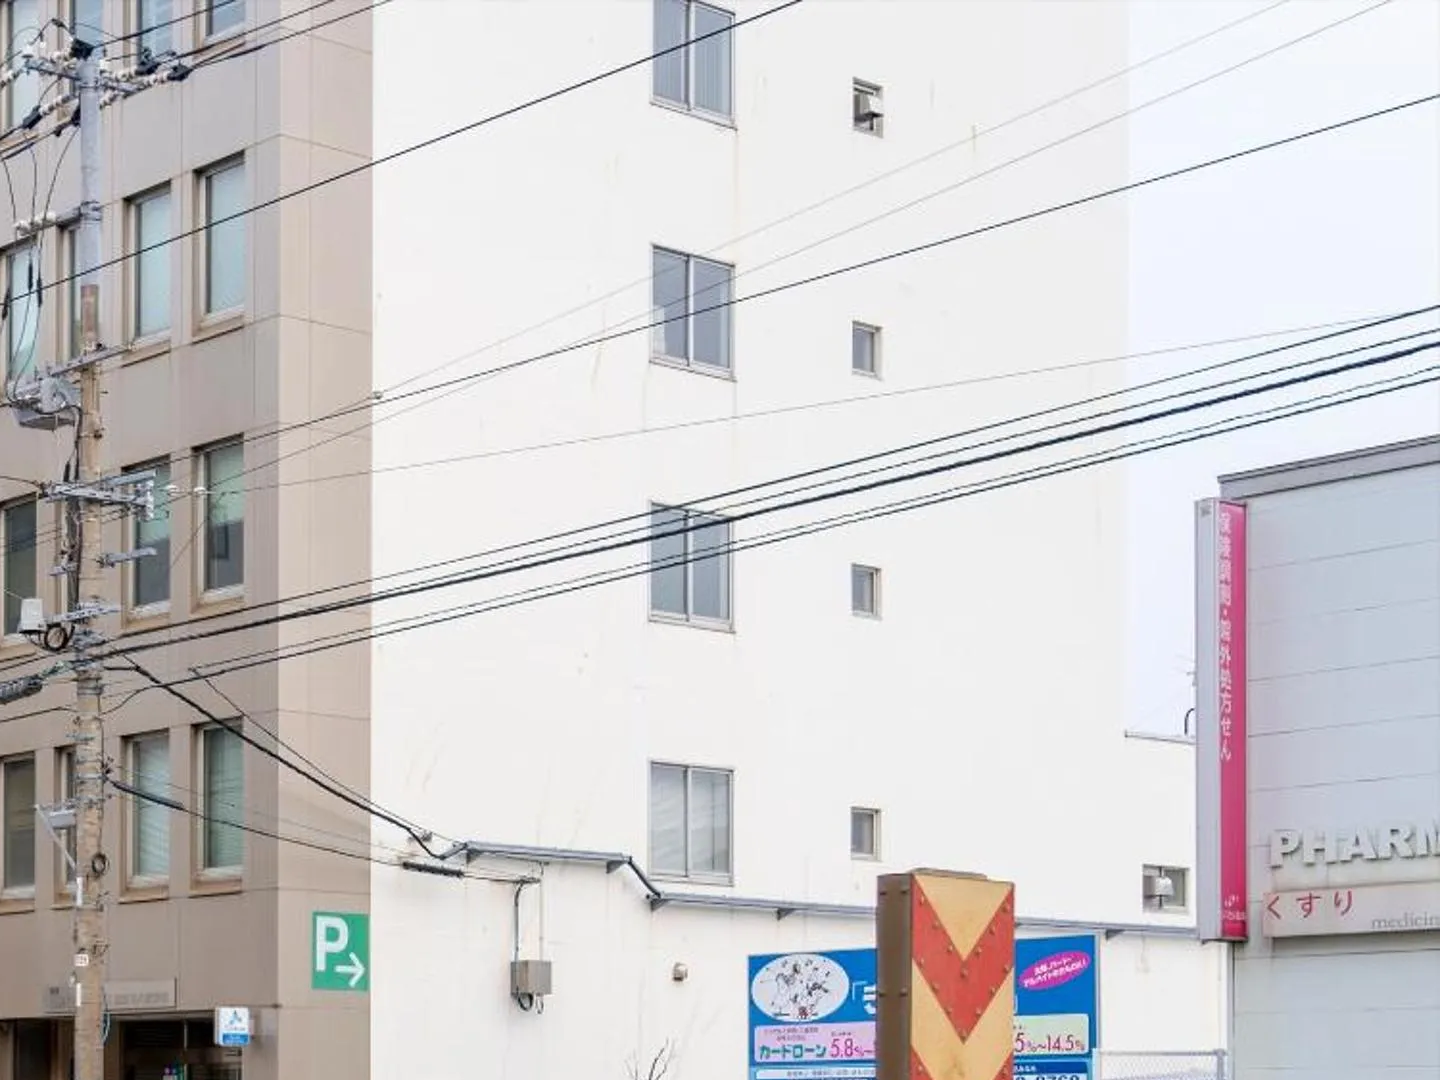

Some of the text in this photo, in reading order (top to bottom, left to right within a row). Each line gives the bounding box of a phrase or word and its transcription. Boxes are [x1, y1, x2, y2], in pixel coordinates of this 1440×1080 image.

[1266, 890, 1353, 919] くすり
[316, 915, 349, 972] P
[759, 1043, 827, 1060] カードローン
